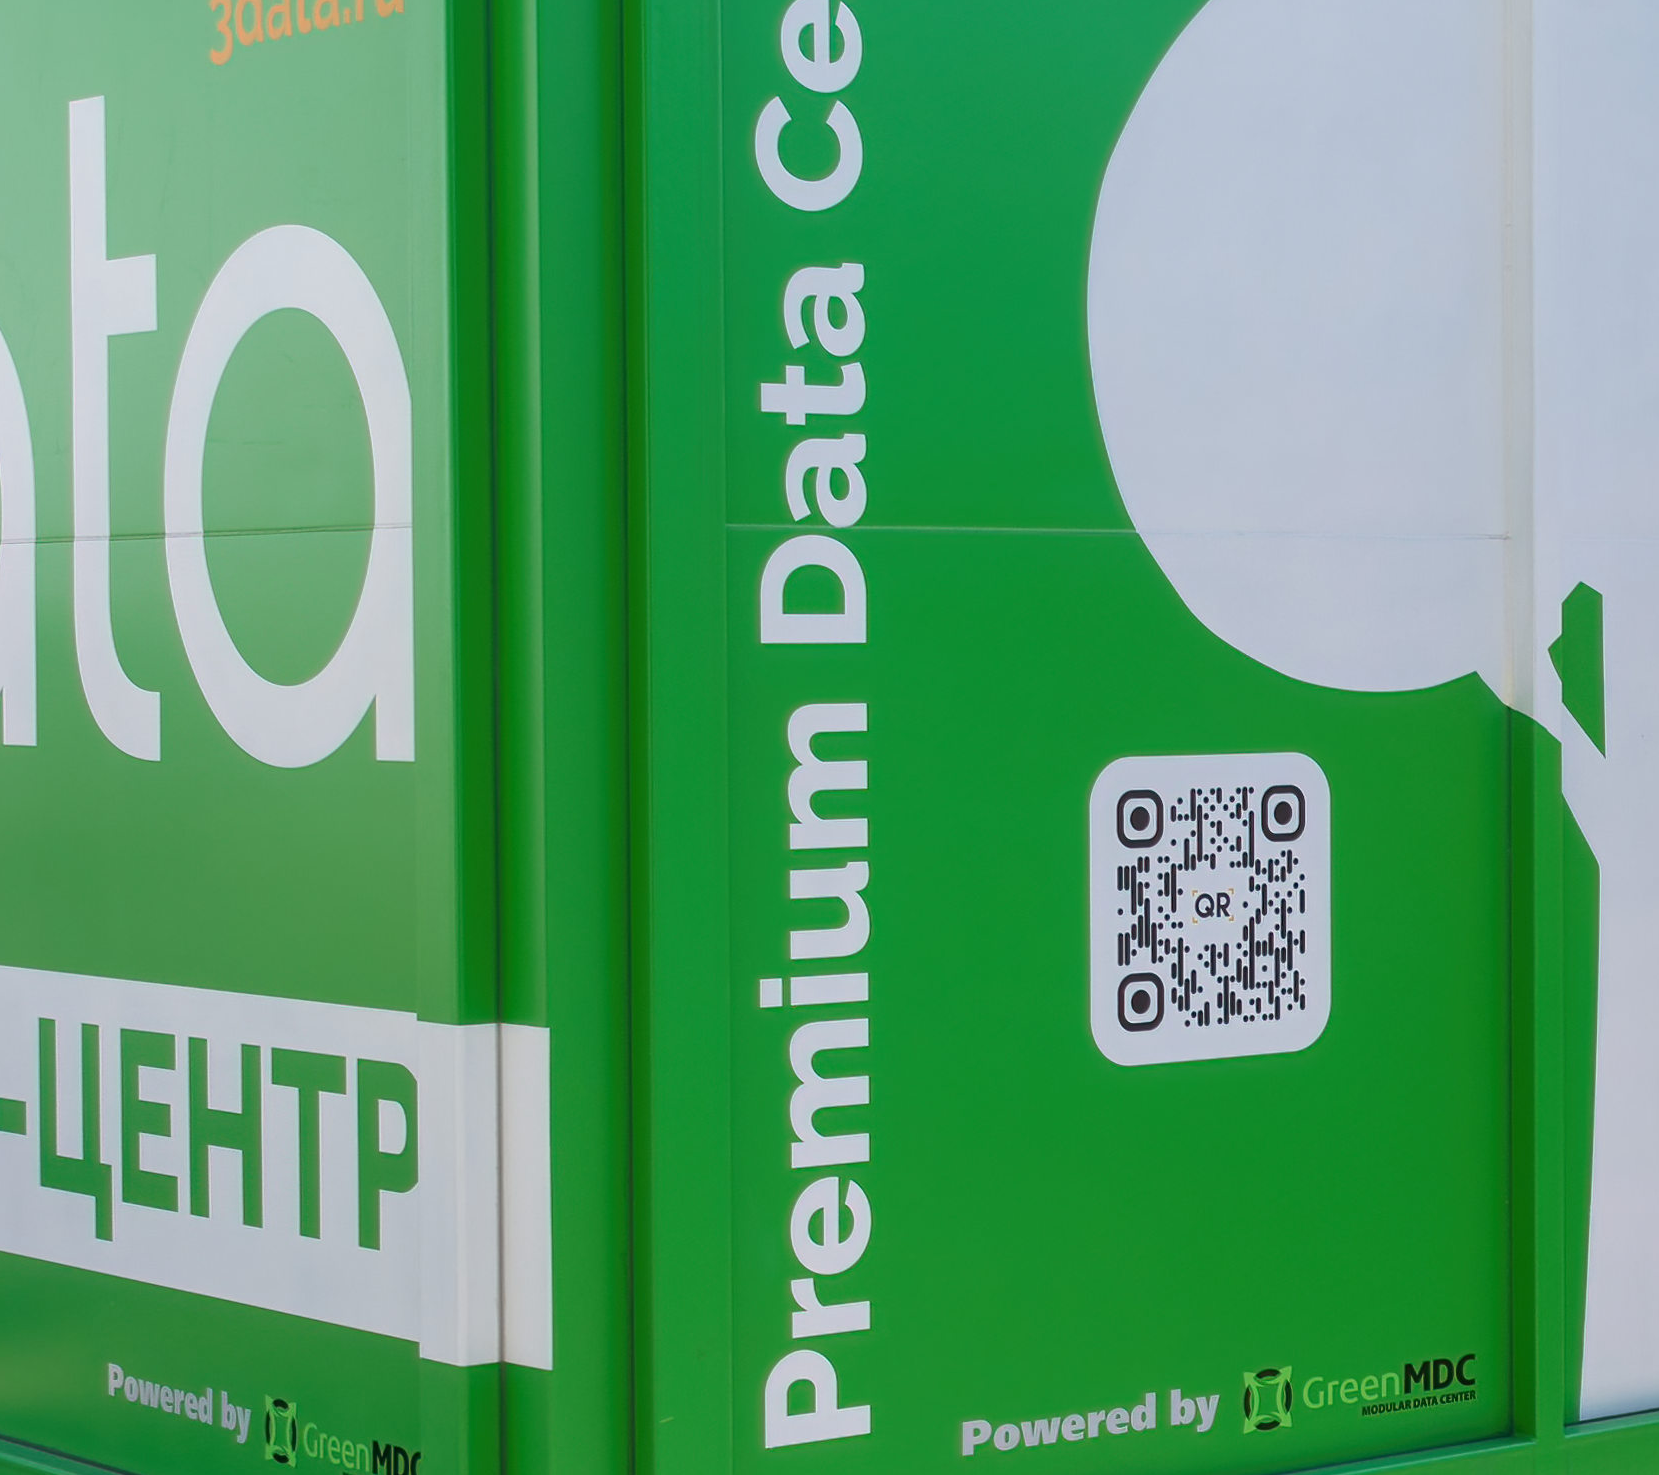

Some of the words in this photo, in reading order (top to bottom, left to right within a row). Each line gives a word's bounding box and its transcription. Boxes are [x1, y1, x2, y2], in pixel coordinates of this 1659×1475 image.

[759, 262, 869, 645] Data
[1194, 891, 1232, 920] QR
[759, 701, 874, 1451] Premium
[108, 1362, 214, 1426] Powered
[221, 1390, 252, 1444] by
[1302, 1353, 1477, 1410] GreenMDC
[1361, 1399, 1412, 1417] MODULAR
[1412, 1395, 1439, 1409] DATA
[1440, 1390, 1477, 1405] CENTER
[961, 1391, 1158, 1456] Powered
[1170, 1388, 1220, 1433] by
